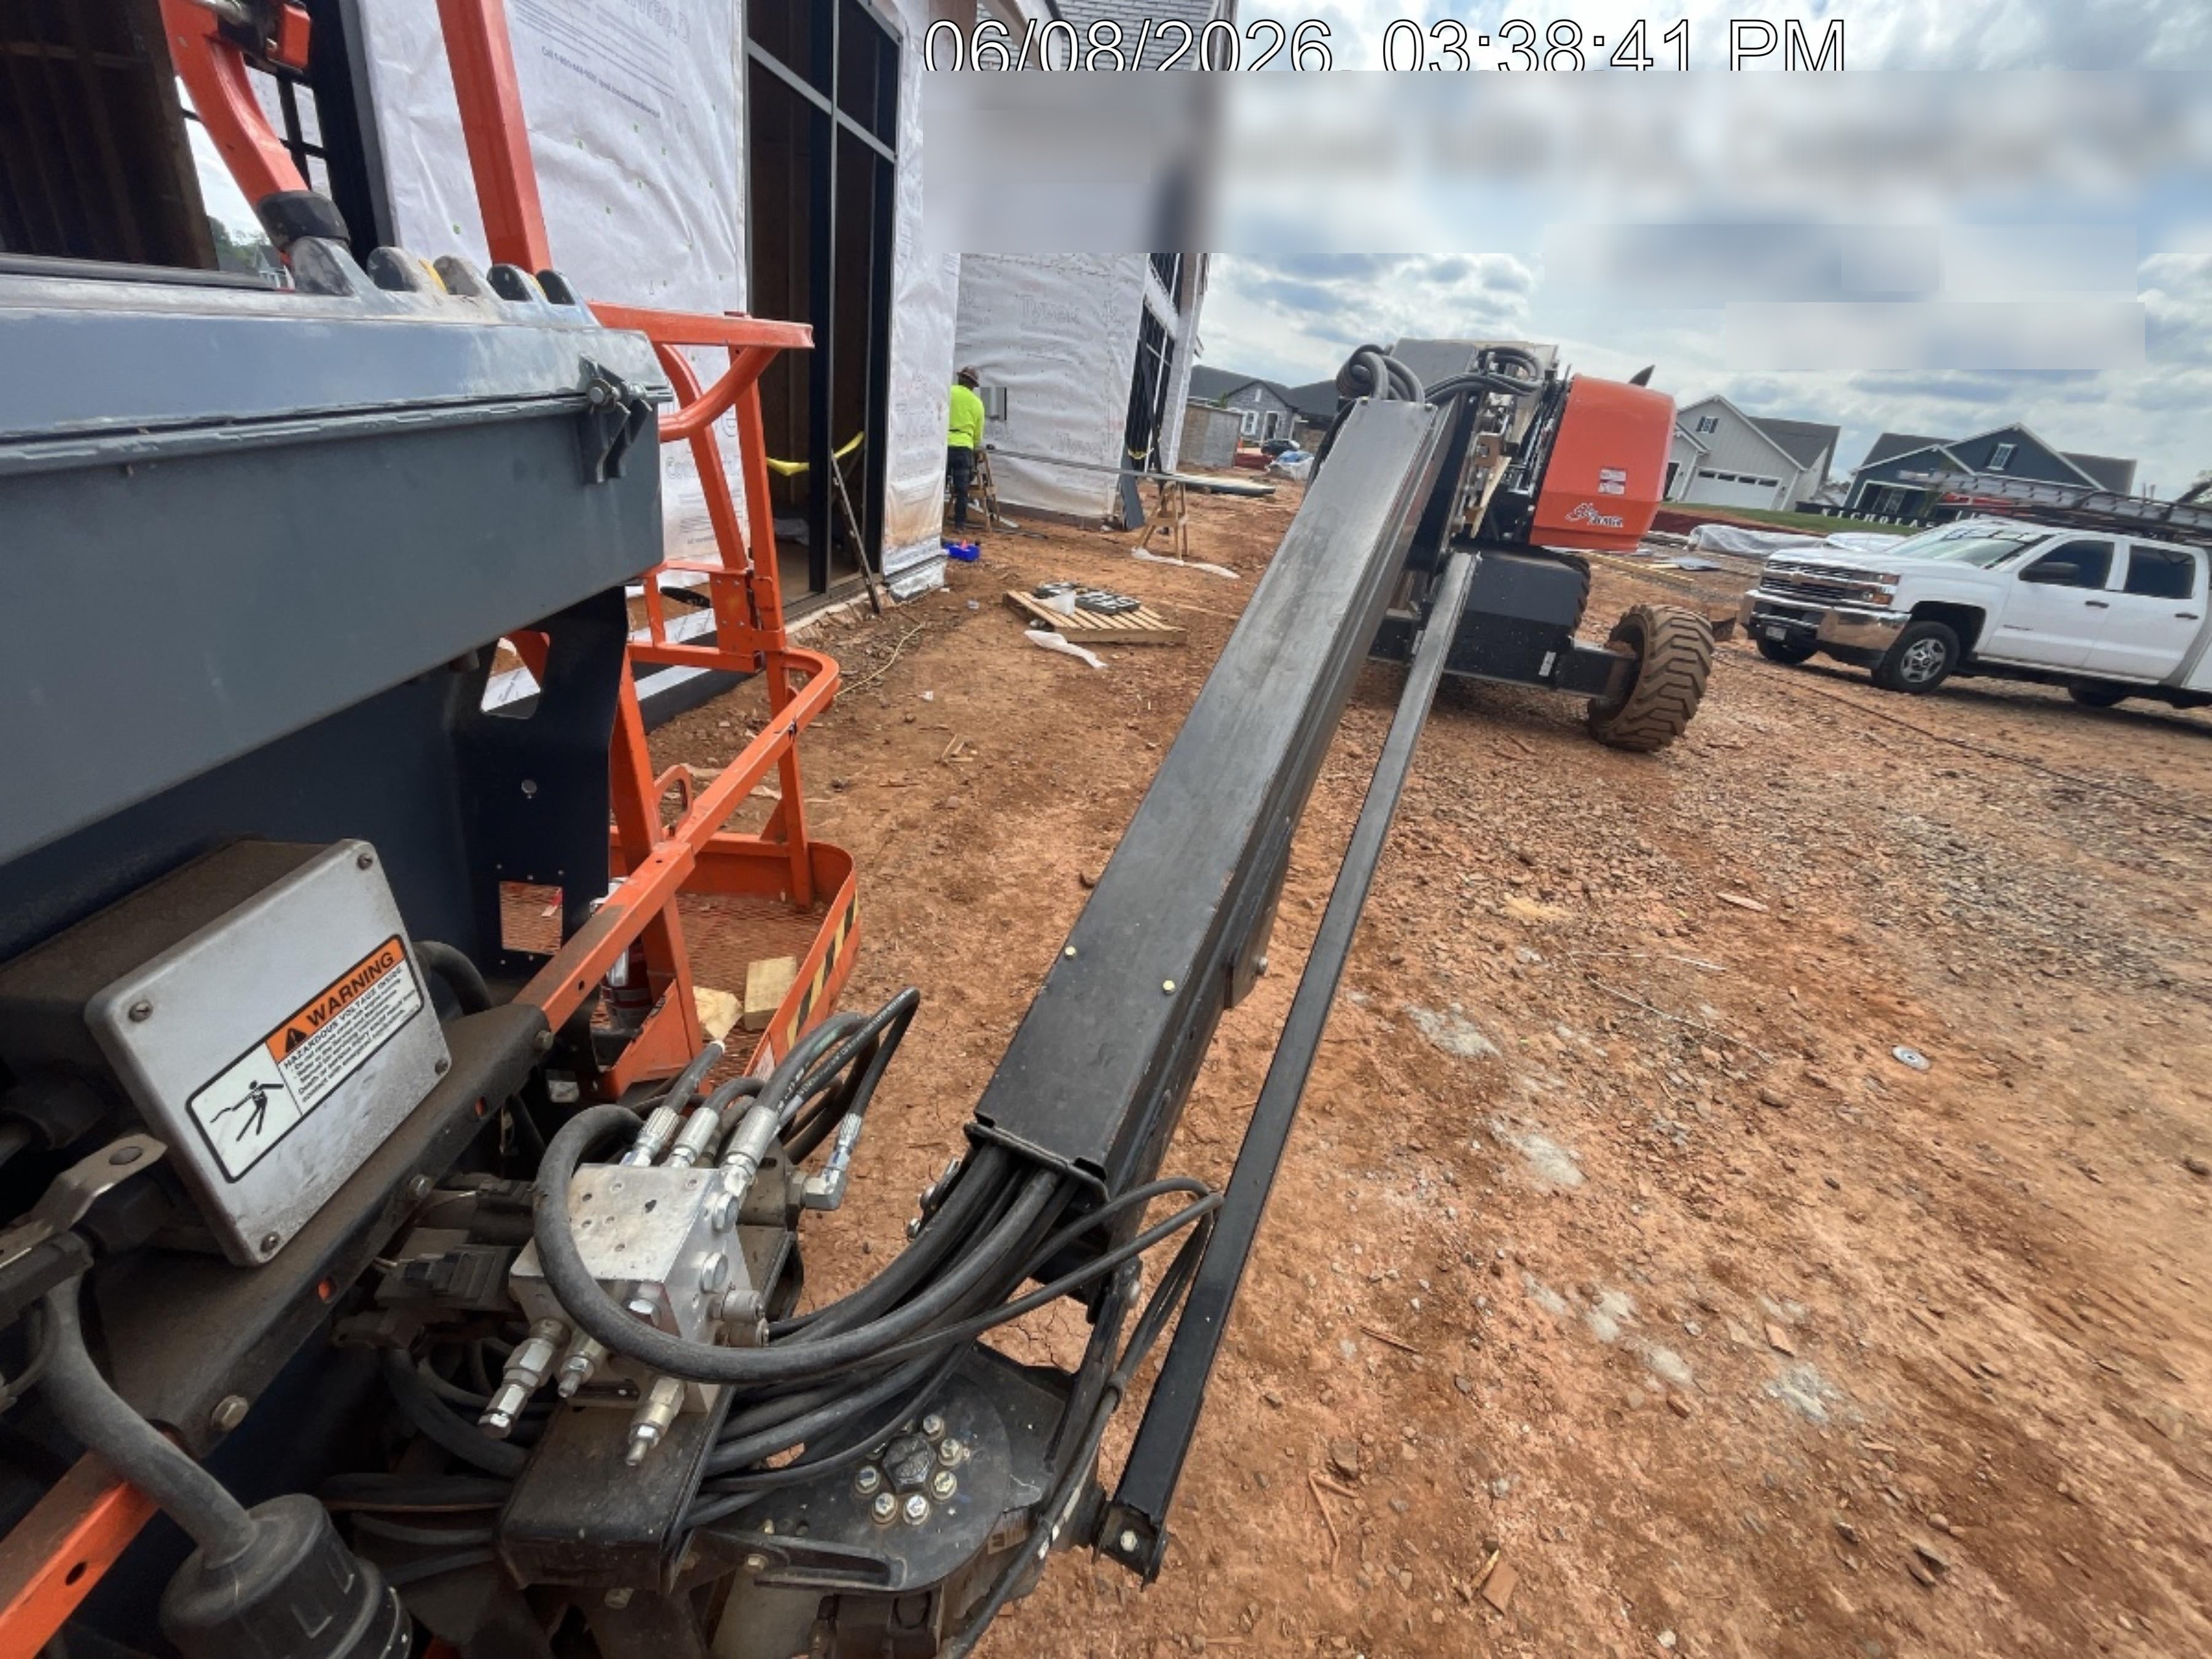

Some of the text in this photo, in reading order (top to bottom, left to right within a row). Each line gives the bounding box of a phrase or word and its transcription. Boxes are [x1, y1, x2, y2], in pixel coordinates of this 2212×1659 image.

[284, 1021, 338, 1069] HAZARDOUS
[339, 988, 376, 1021] VOLTAGE
[306, 952, 394, 1027] WARNING
